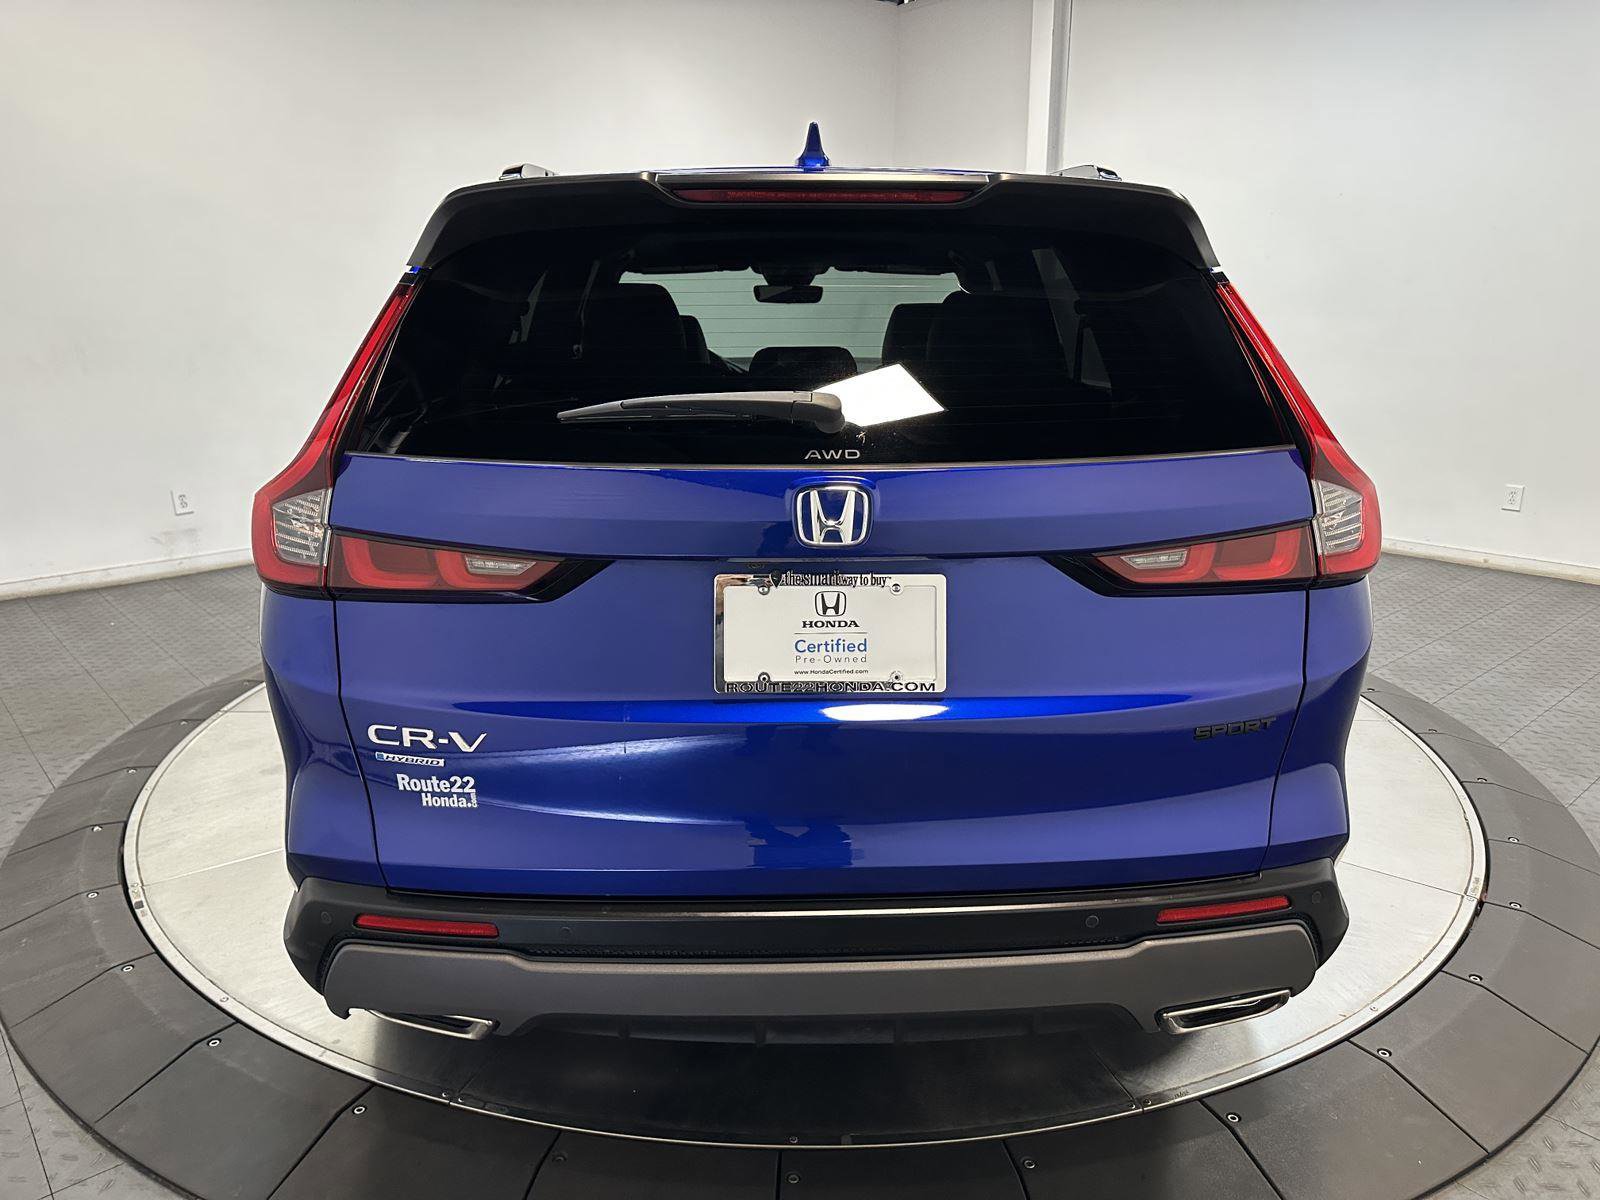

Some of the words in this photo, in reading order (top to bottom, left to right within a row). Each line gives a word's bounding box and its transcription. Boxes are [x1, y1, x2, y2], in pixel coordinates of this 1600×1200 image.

[804, 449, 860, 460] AWD
[841, 574, 858, 588] way
[859, 573, 869, 586] to
[802, 620, 860, 628] HONDA
[794, 638, 867, 653] Certified
[795, 654, 867, 663] Pre-Owned
[726, 681, 936, 693] ROUTE22HONDA.COM
[1194, 715, 1277, 740] SPORT
[367, 724, 488, 752] CR-V
[396, 773, 476, 793] Route22
